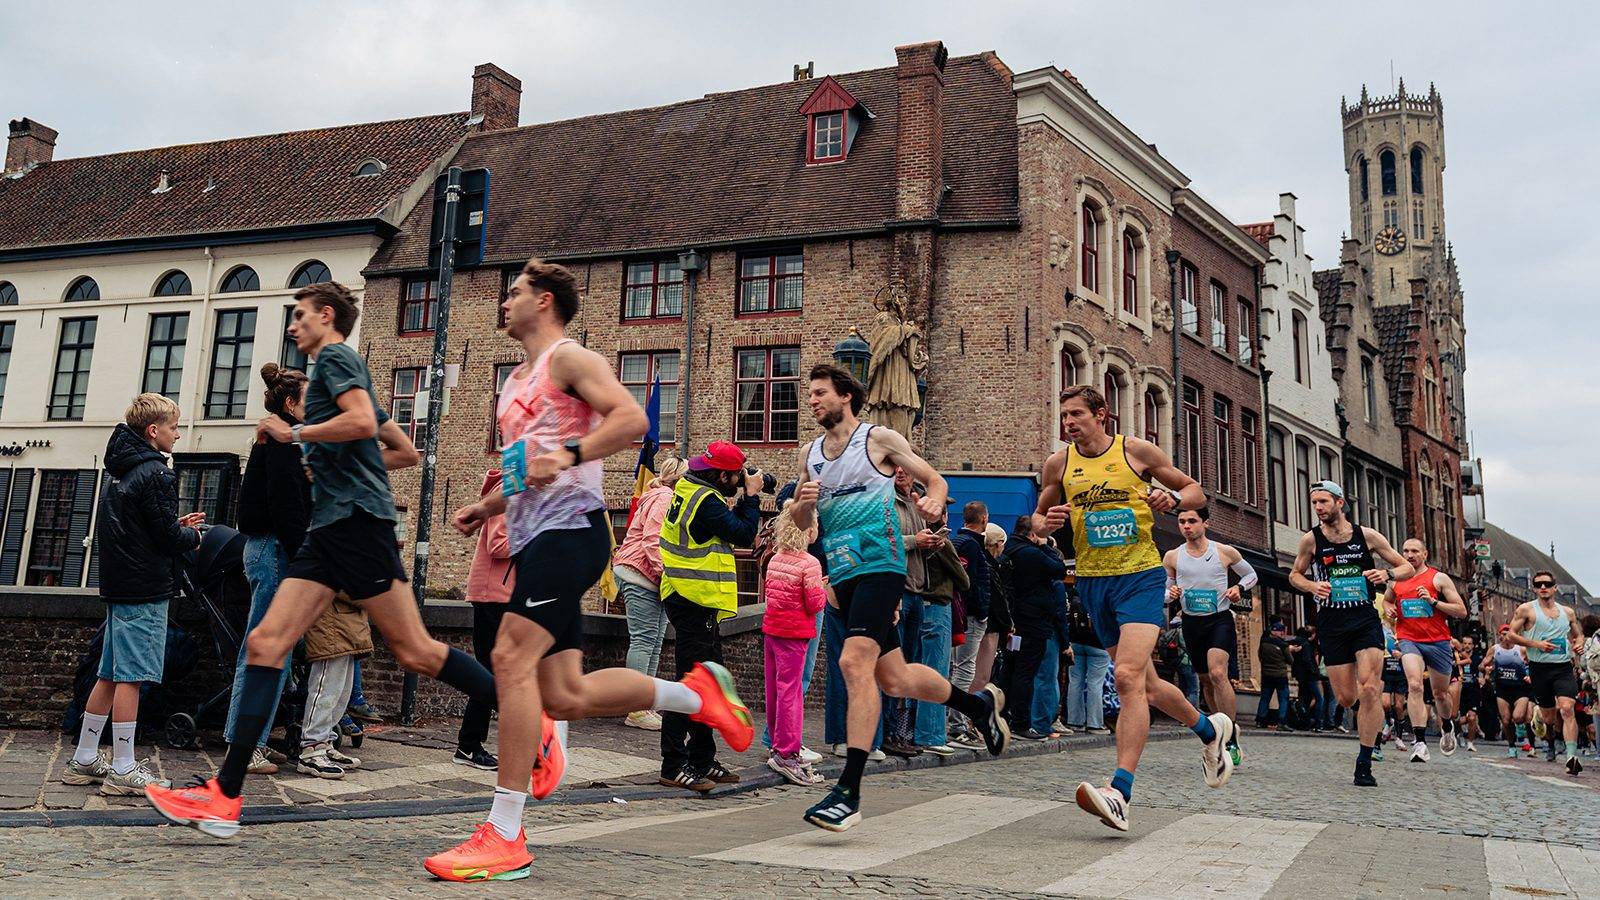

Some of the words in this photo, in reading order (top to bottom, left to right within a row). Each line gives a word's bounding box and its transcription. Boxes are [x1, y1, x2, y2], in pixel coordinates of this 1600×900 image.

[0, 441, 26, 456] rie
[1099, 513, 1129, 521] ATHORA
[1094, 522, 1133, 539] 12327
